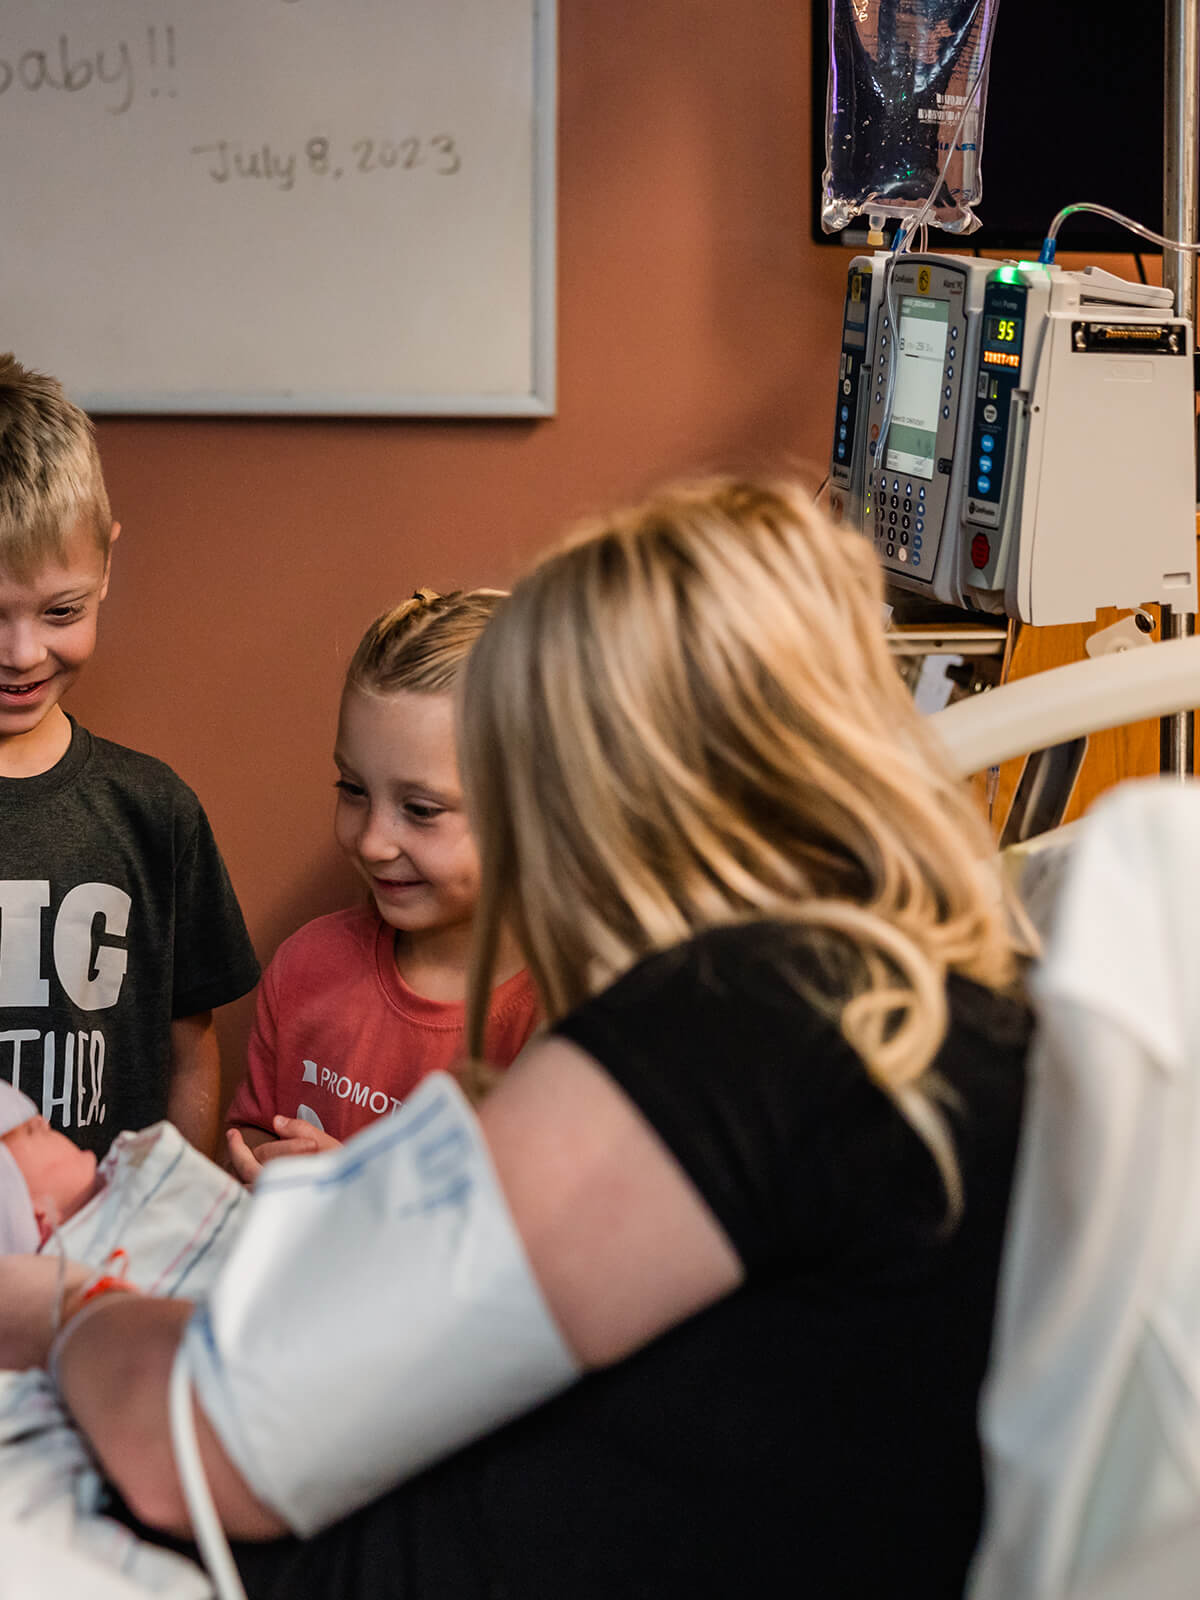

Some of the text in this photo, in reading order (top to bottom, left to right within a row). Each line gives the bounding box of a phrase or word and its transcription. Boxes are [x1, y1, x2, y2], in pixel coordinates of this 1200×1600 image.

[191, 141, 296, 191] July
[352, 134, 462, 177] 2023
[997, 319, 1015, 341] 95
